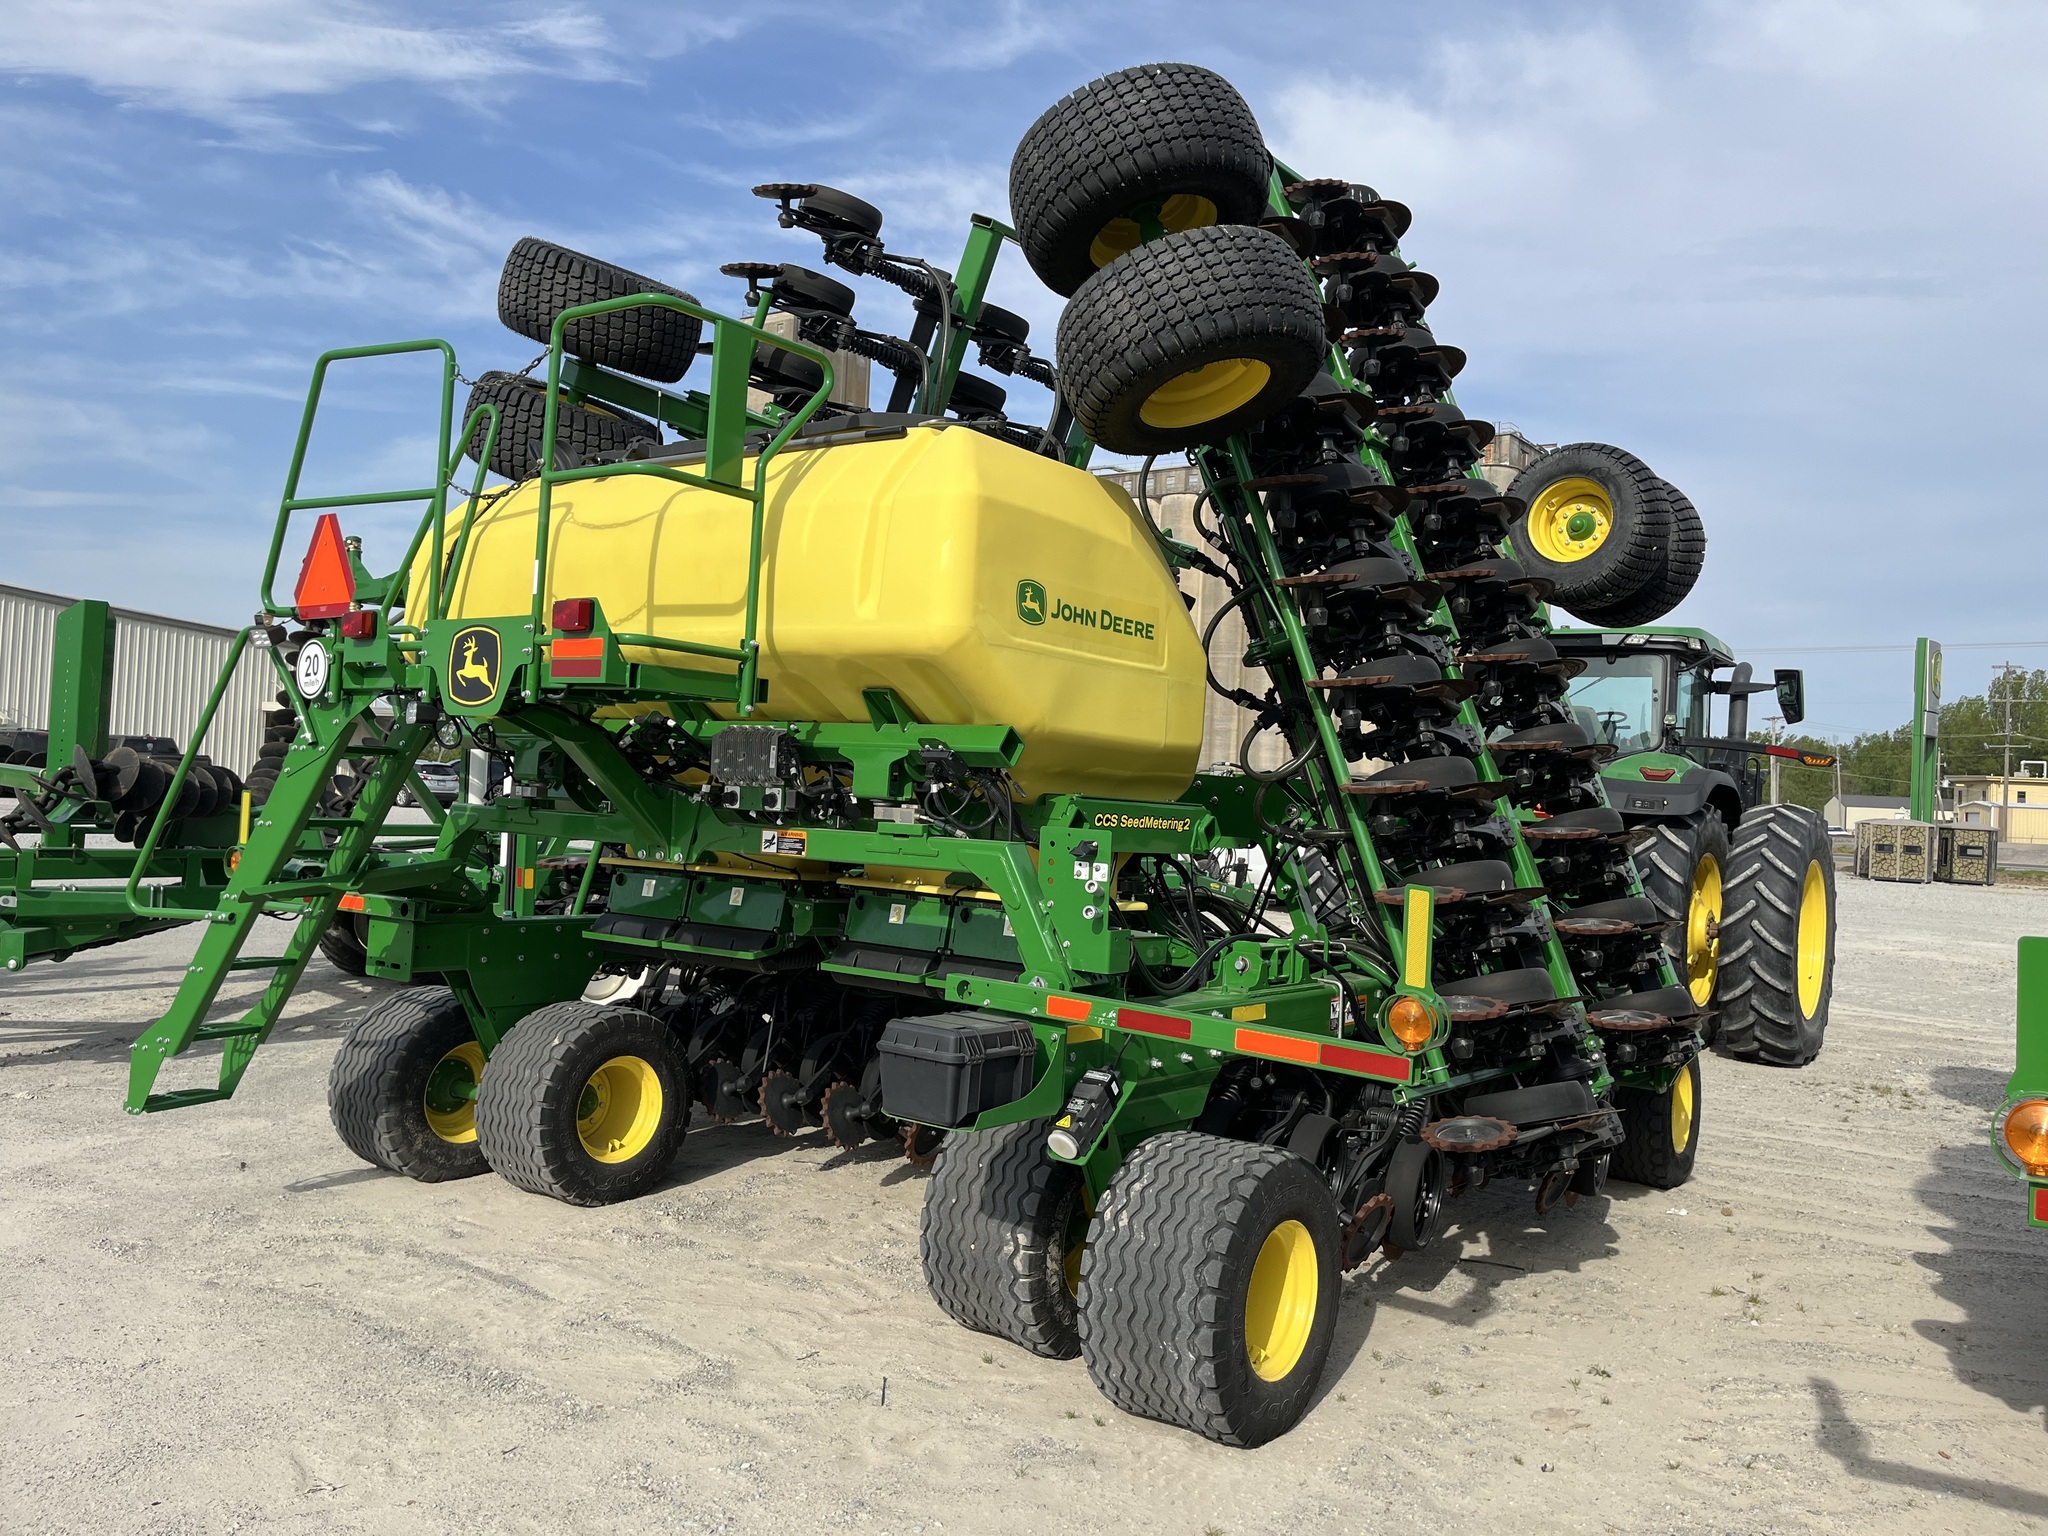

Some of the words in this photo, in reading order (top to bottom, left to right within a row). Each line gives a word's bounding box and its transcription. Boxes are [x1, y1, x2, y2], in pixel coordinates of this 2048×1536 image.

[1051, 599, 1096, 628] JOHN
[1100, 610, 1155, 641] DEERE
[305, 653, 319, 678] 20
[1094, 813, 1118, 828] CCS
[1120, 814, 1191, 832] SeedMetering2
[645, 881, 652, 895] 1
[731, 889, 741, 904] 2
[891, 906, 902, 922] 3
